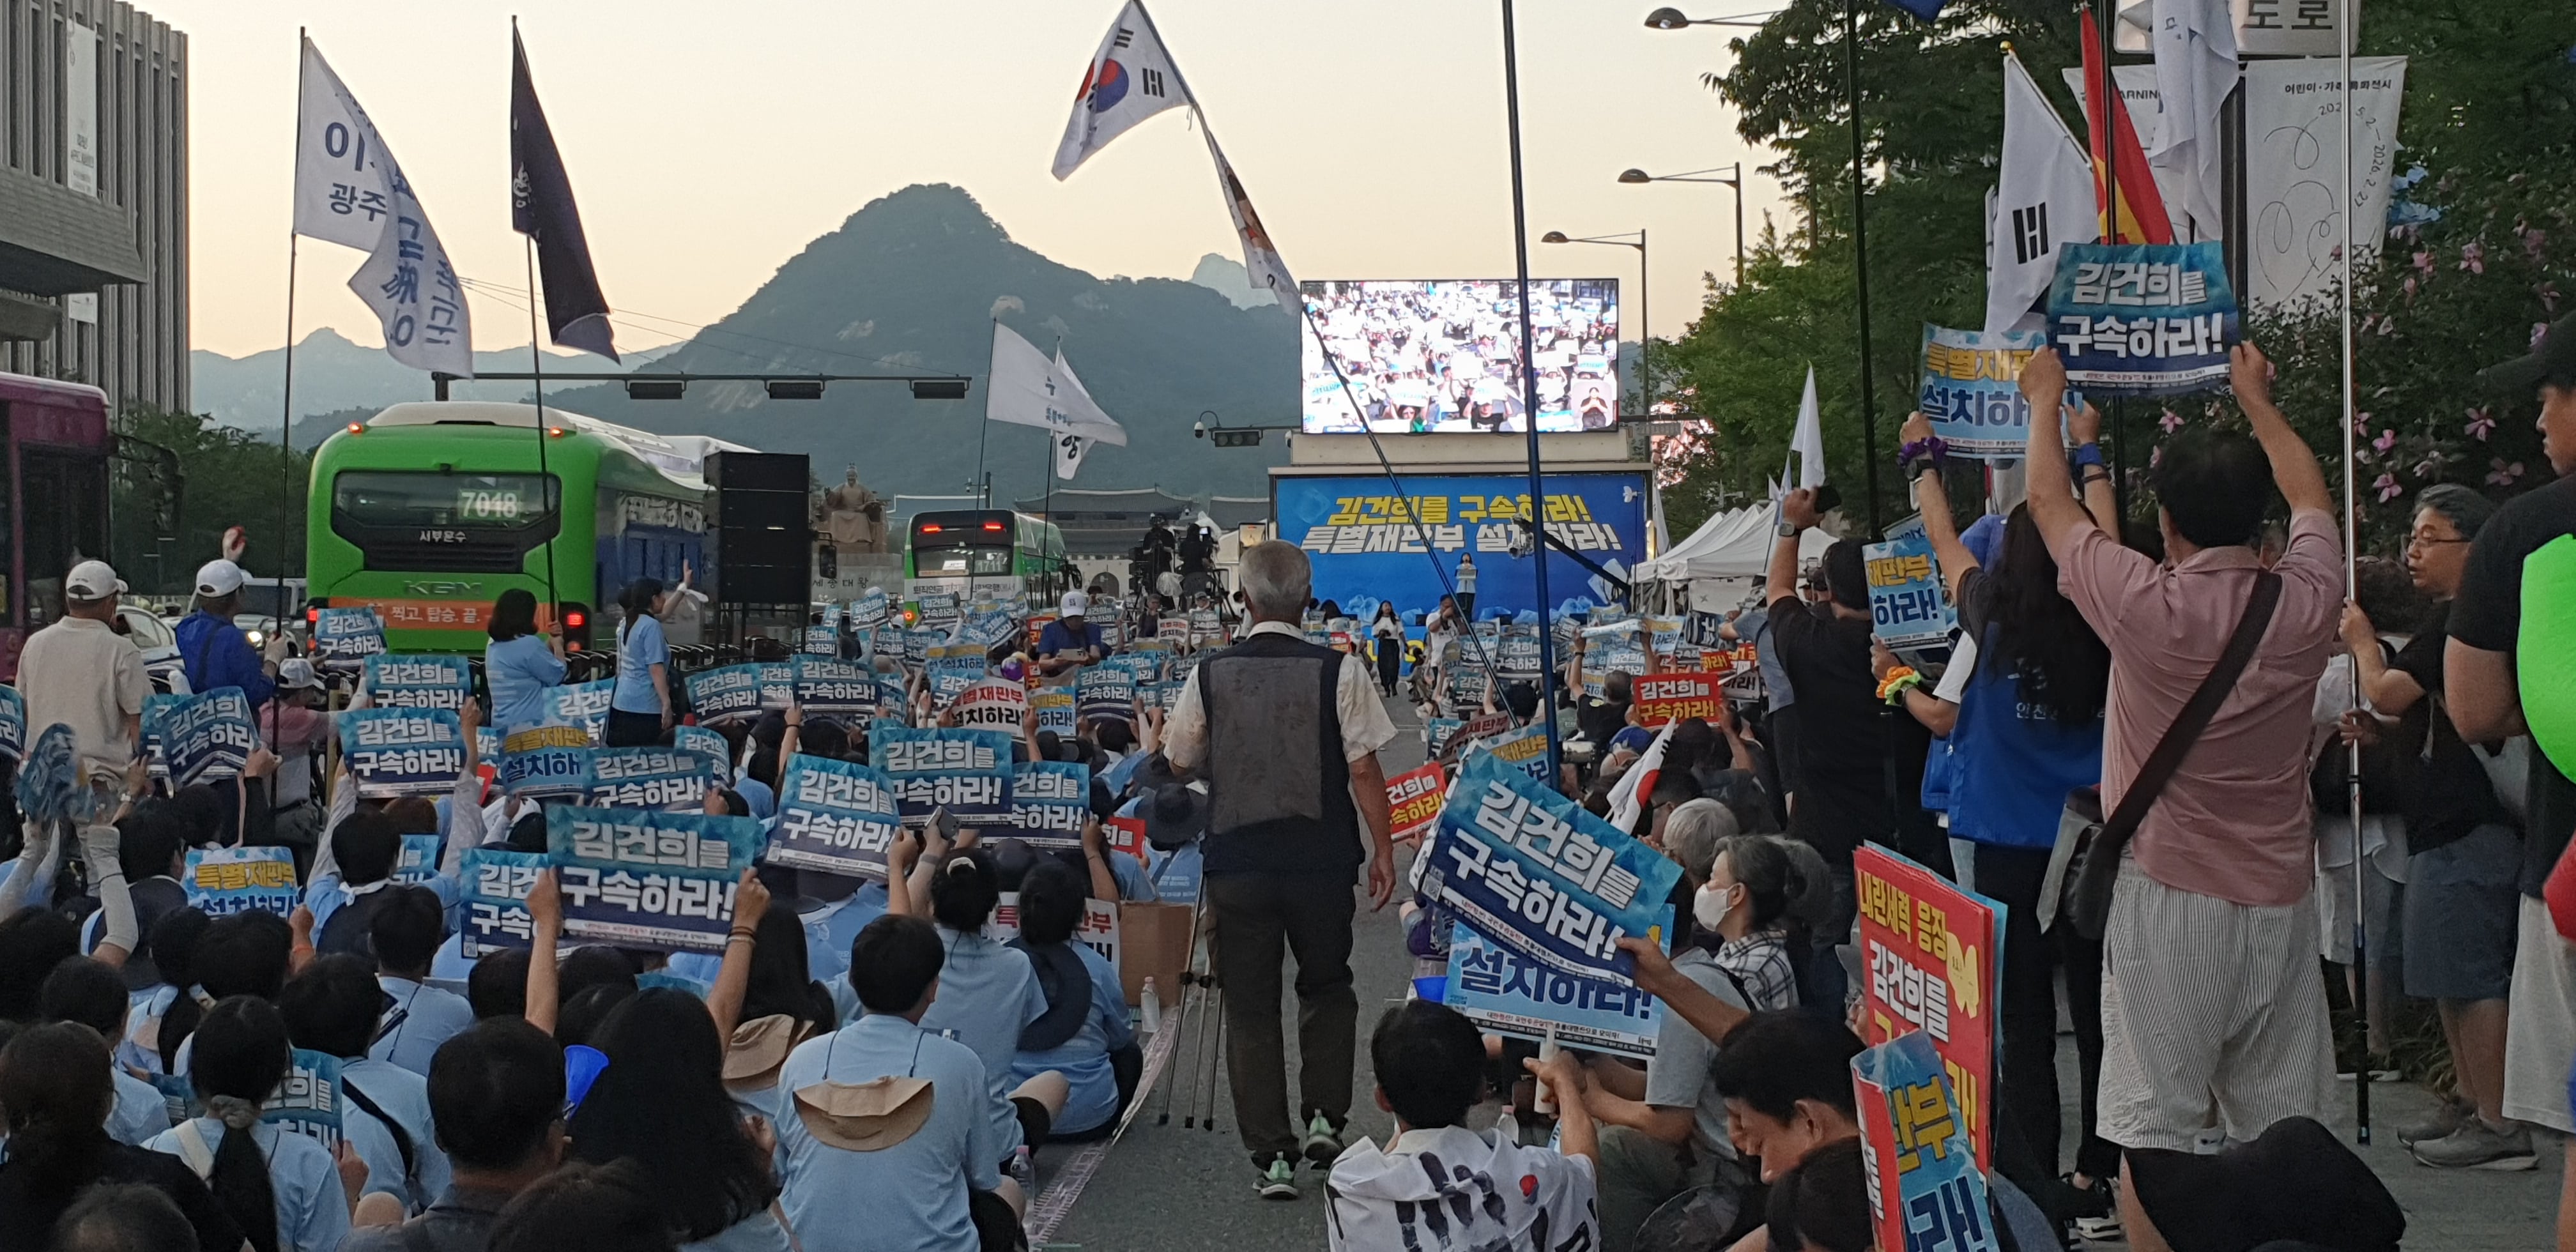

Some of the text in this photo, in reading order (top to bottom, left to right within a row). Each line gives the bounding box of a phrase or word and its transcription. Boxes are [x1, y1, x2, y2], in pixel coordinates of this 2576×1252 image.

[2119, 89, 2159, 100] ARNIN
[2072, 263, 2207, 306] 김건희를
[2057, 312, 2224, 358] 구속하라!
[1928, 342, 2032, 382] 특별재
[1922, 385, 2023, 427] 설치하
[1327, 494, 1592, 526] 김건희를 구속하라!
[420, 530, 467, 543] 서부운수
[1301, 524, 1466, 554] 특별재판부
[812, 577, 869, 589] 세종대왕
[1868, 554, 1932, 588] 재판부
[853, 607, 885, 625] 구속하라!
[922, 608, 958, 618] 구속하라!
[1872, 588, 1938, 625] 하라!
[805, 643, 835, 655] 속하라!
[807, 630, 833, 641] 건희를
[378, 664, 457, 685] 김건희를
[801, 661, 870, 681] 김건희를
[1080, 669, 1130, 686] 김건희를
[1496, 657, 1541, 670] 구속하라
[694, 671, 753, 698] 김건희를
[799, 682, 876, 701] 구속하라!
[962, 686, 1024, 706] 별재판부
[1078, 685, 1132, 703] 구속하라!
[1640, 679, 1710, 701] 김건희를
[376, 689, 464, 709] 구속하라!
[695, 689, 757, 716] 구속하라!
[1640, 700, 1715, 721] 구속하라!
[169, 695, 246, 740] 김건희
[953, 706, 1022, 727] 치하라
[1040, 710, 1073, 728] 하라!
[171, 722, 256, 767] 구속하라
[356, 717, 453, 745] 김건희를
[353, 748, 461, 777] 구속하라!
[505, 752, 581, 783] 설치하
[596, 753, 696, 781] 김건희를
[887, 740, 995, 772] 김건희를
[593, 775, 704, 809] 구속하라!
[799, 768, 894, 816] 김건희를
[893, 776, 1002, 805] 구속하라!
[1012, 772, 1078, 798] 건희를
[1385, 774, 1438, 805] 건희를
[1012, 803, 1084, 831] 속하라!
[572, 821, 730, 869] 김건희를
[1474, 779, 1641, 910] 김건희를
[479, 864, 544, 900] 김건
[560, 866, 739, 922] 구속하라!
[1447, 827, 1626, 961] 구속하라!
[1869, 938, 1950, 1044] 김건희를
